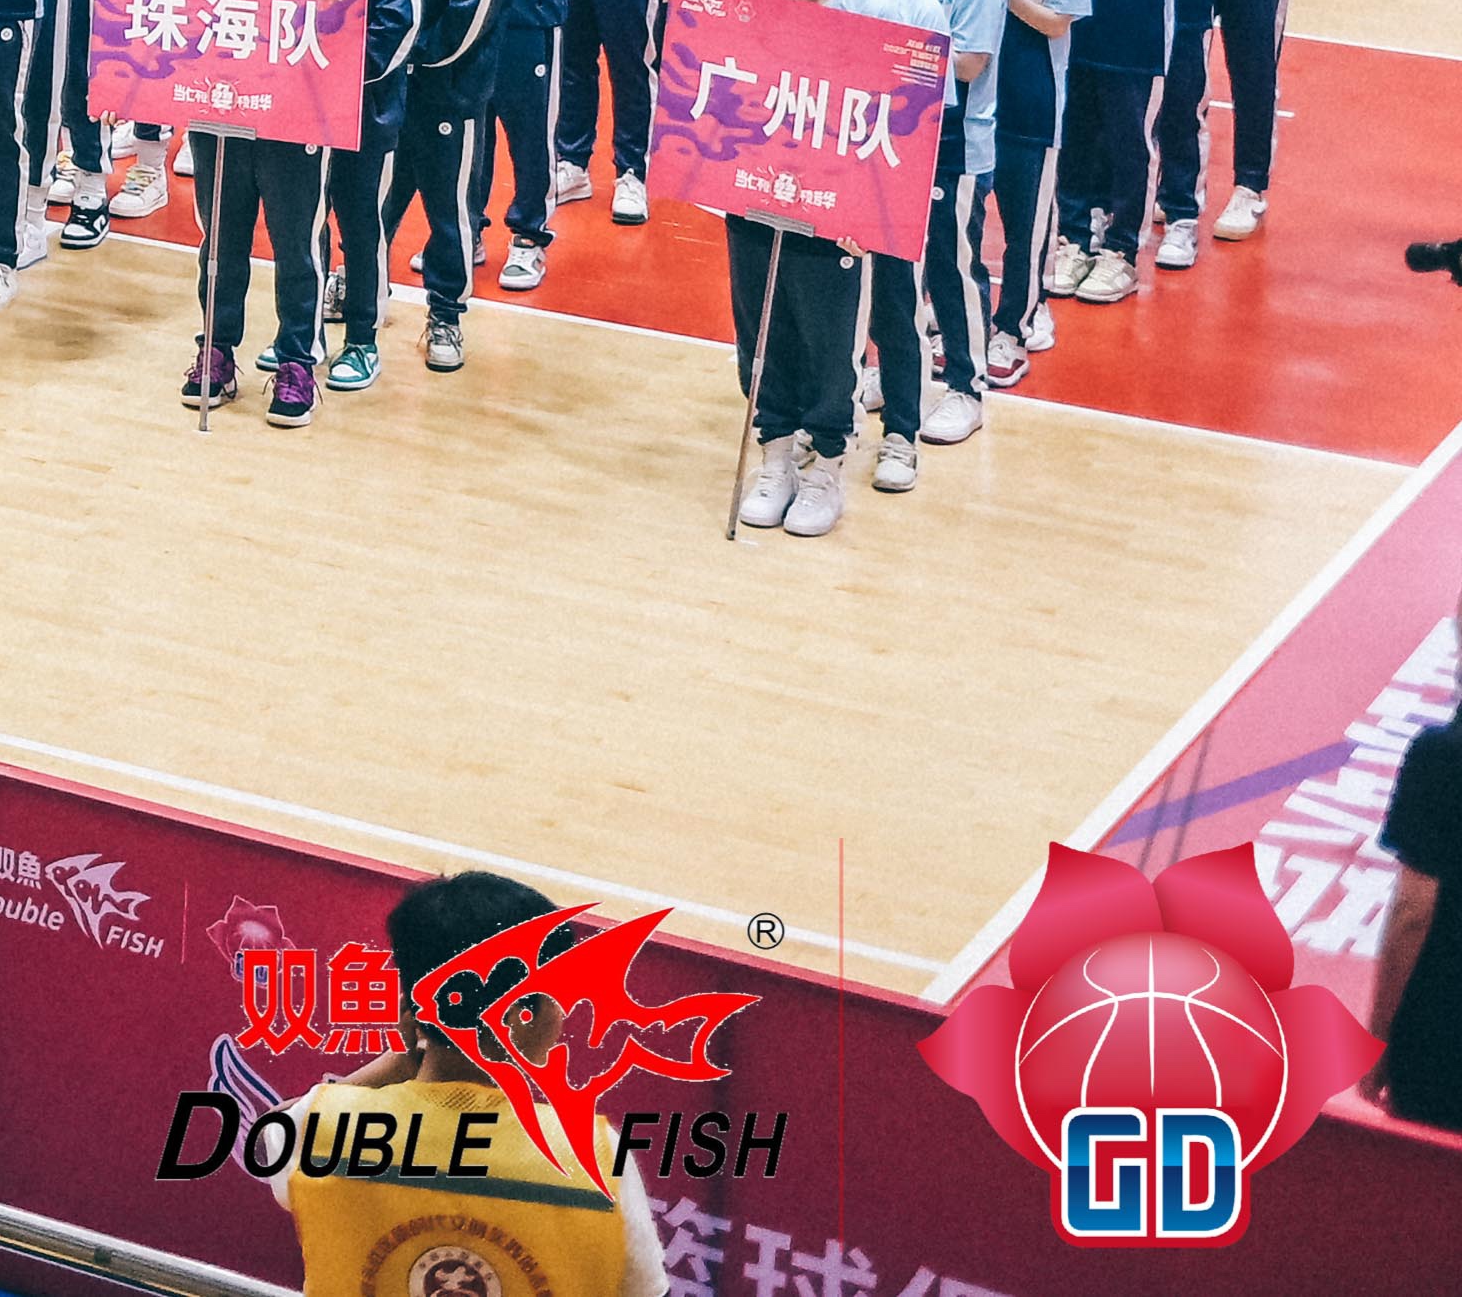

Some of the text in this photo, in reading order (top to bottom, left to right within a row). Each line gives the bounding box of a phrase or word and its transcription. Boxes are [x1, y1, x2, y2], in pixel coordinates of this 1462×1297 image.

[689, 54, 904, 169] 广州队
[105, 924, 165, 959] FISH
